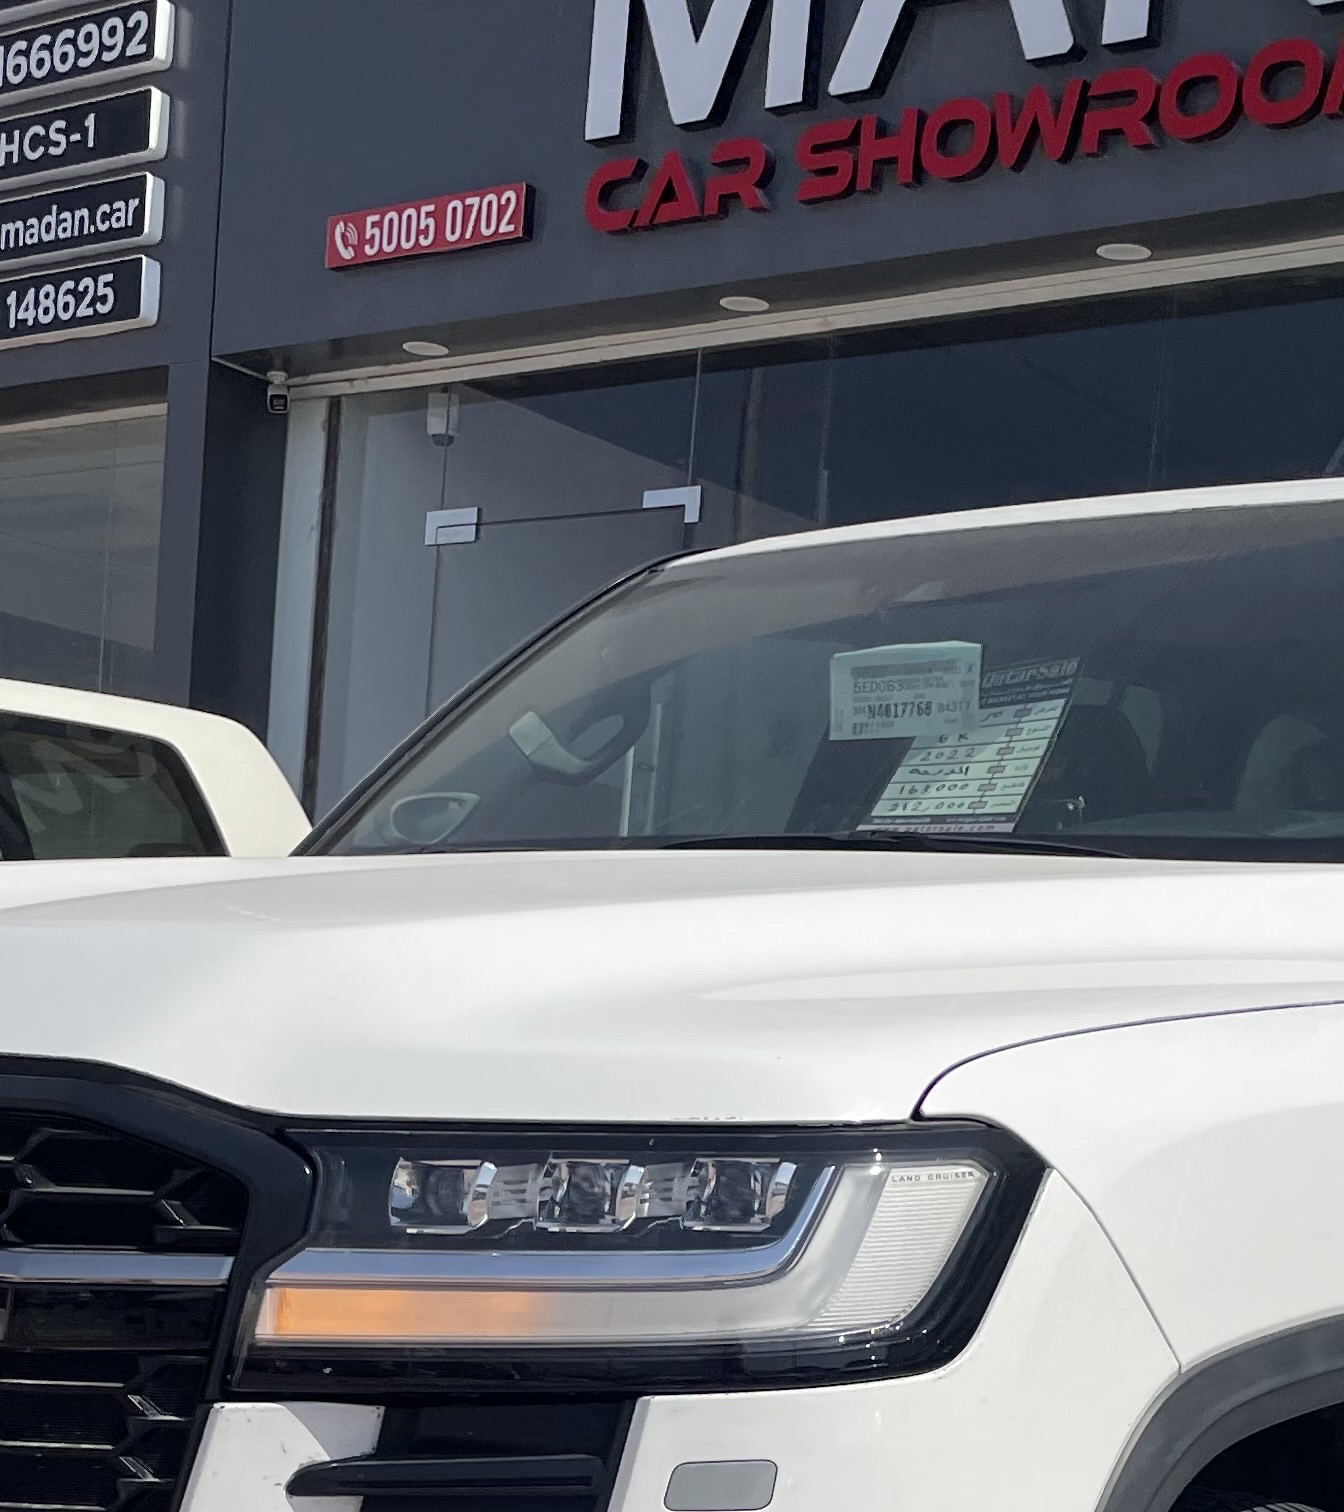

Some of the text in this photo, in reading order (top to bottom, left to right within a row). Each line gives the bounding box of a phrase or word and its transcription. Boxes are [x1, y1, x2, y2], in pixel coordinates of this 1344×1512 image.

[0, 113, 96, 166] HCS-1
[585, 137, 769, 233] CAR
[364, 190, 517, 256] 5005 0702
[6, 273, 114, 328] 148625
[892, 1170, 975, 1183] LAND CRUISER
